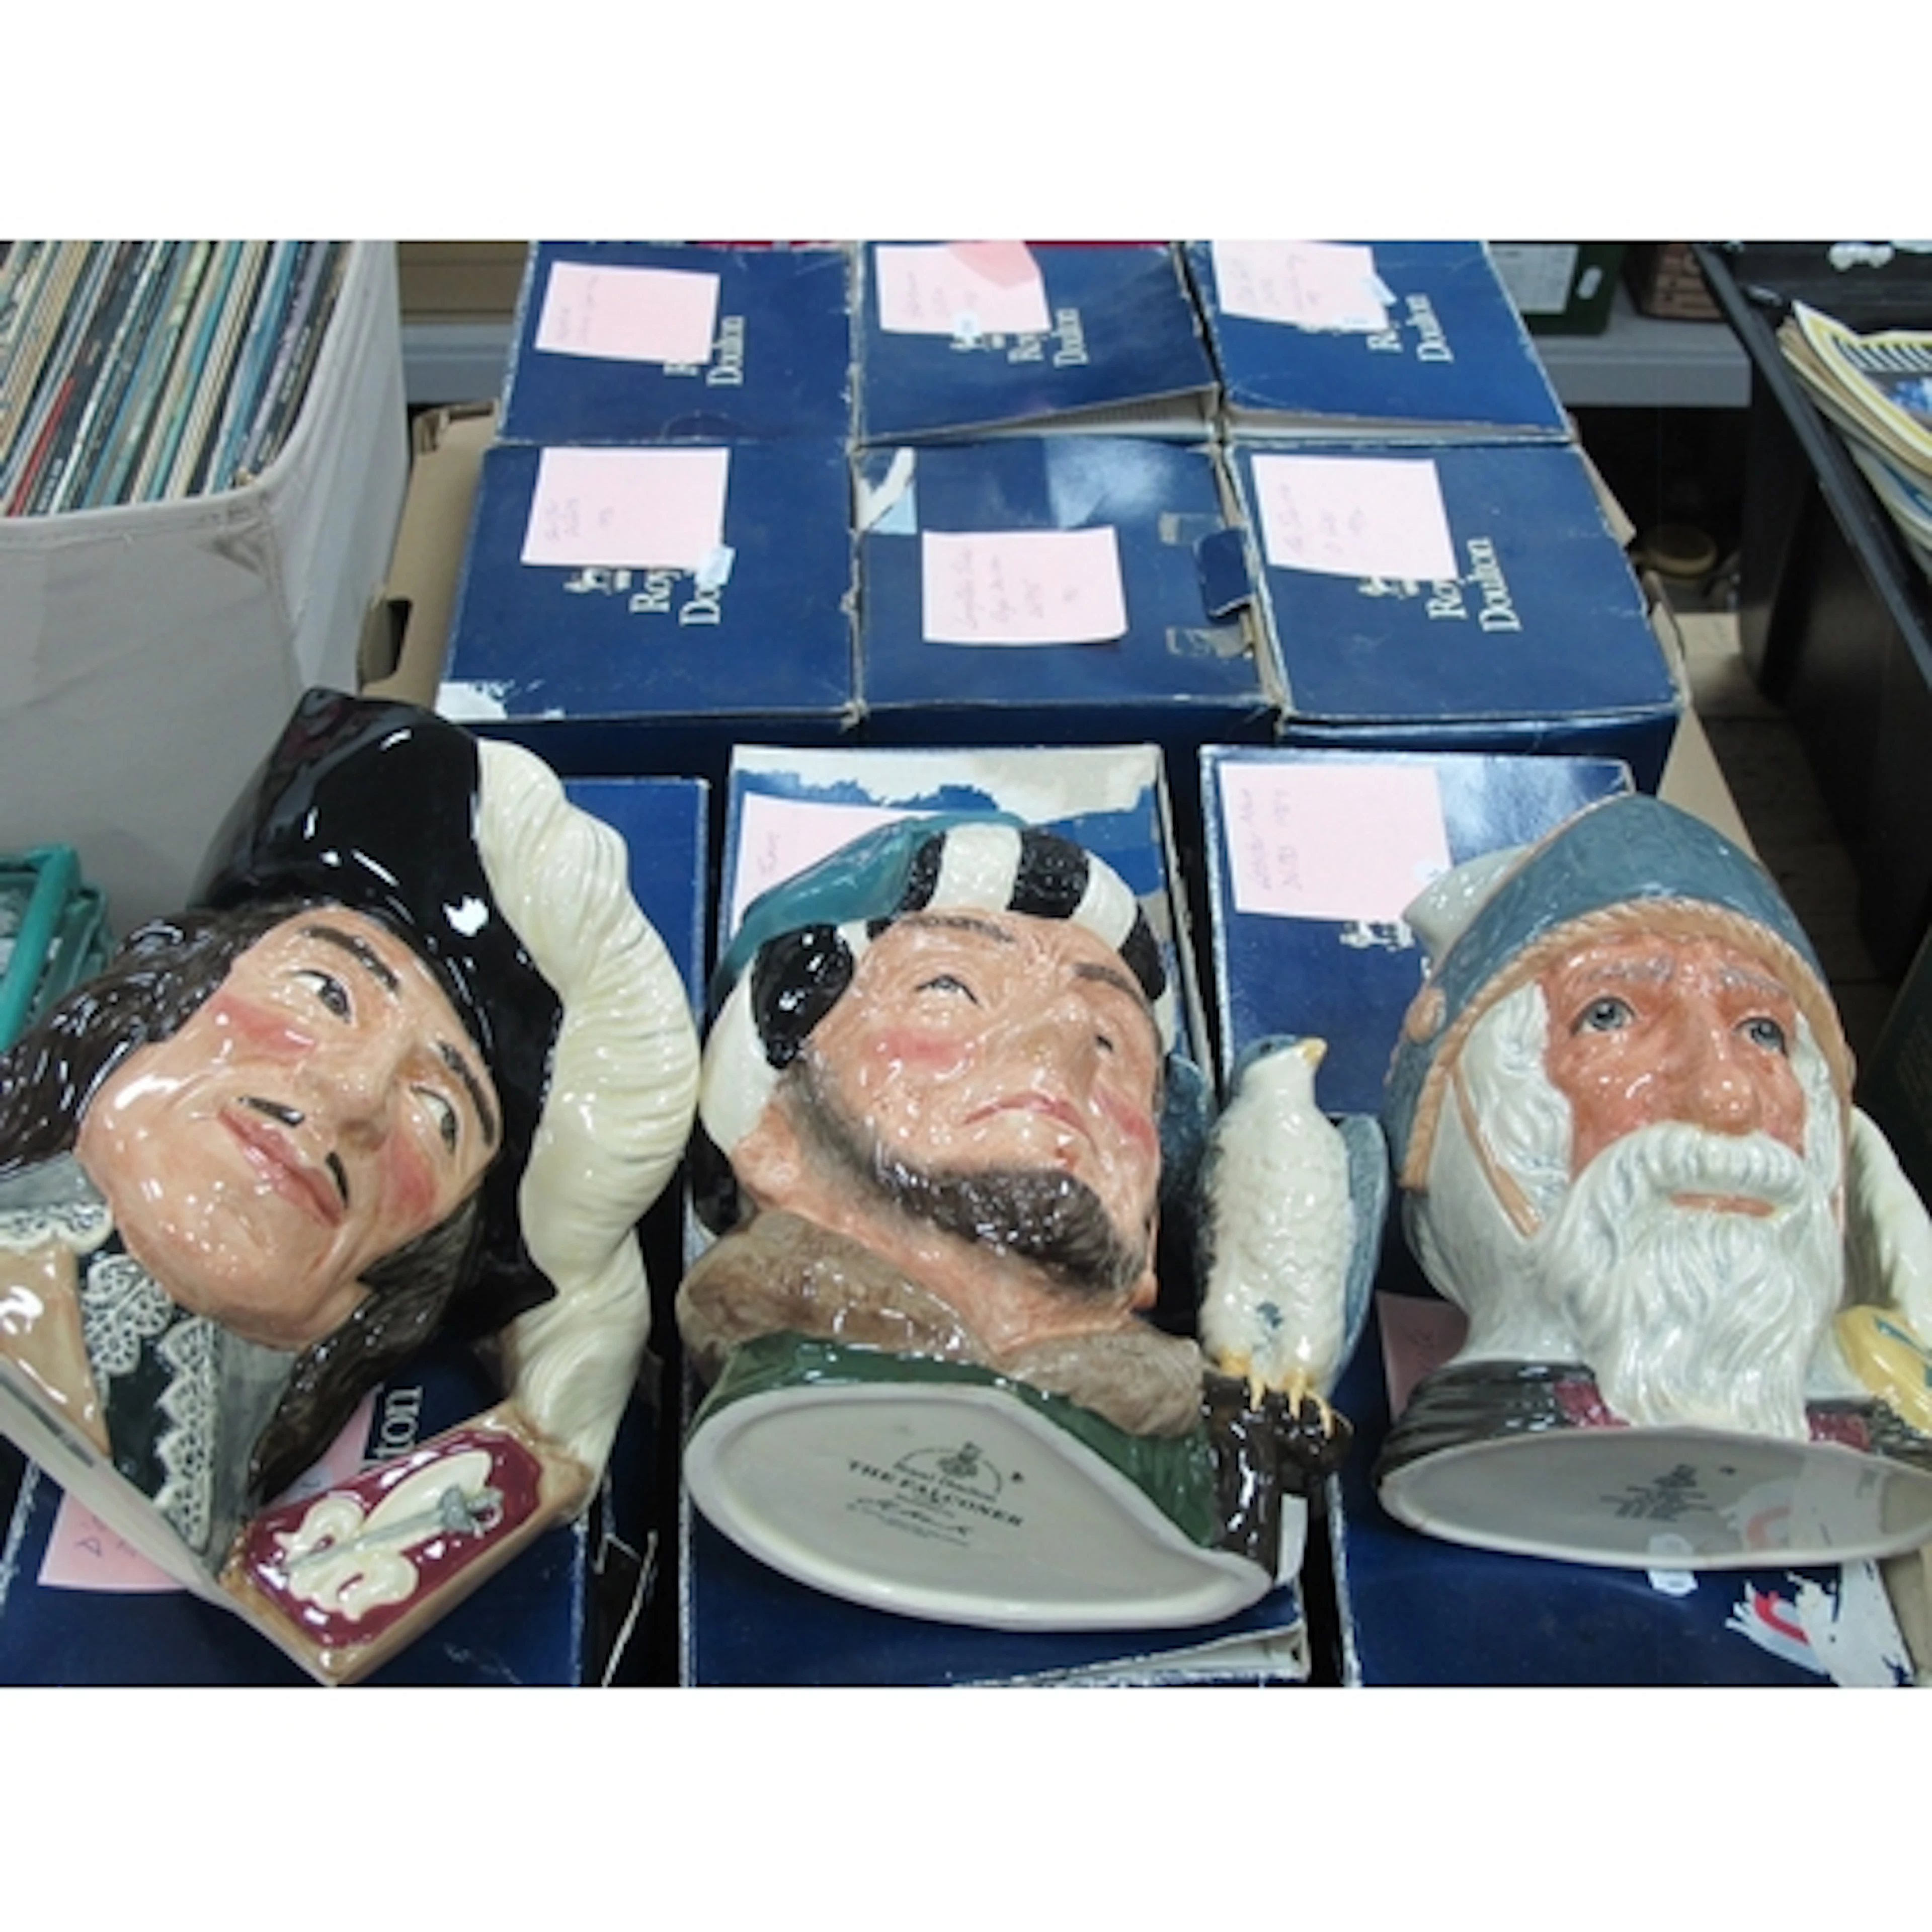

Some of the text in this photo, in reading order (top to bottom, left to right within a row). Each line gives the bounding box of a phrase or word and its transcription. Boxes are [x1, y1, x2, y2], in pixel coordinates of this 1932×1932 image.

[629, 570, 681, 613] Roy
[1466, 536, 1522, 633] Doulton
[848, 1459, 895, 1483] THE
[900, 1479, 1024, 1527] FALCONER
